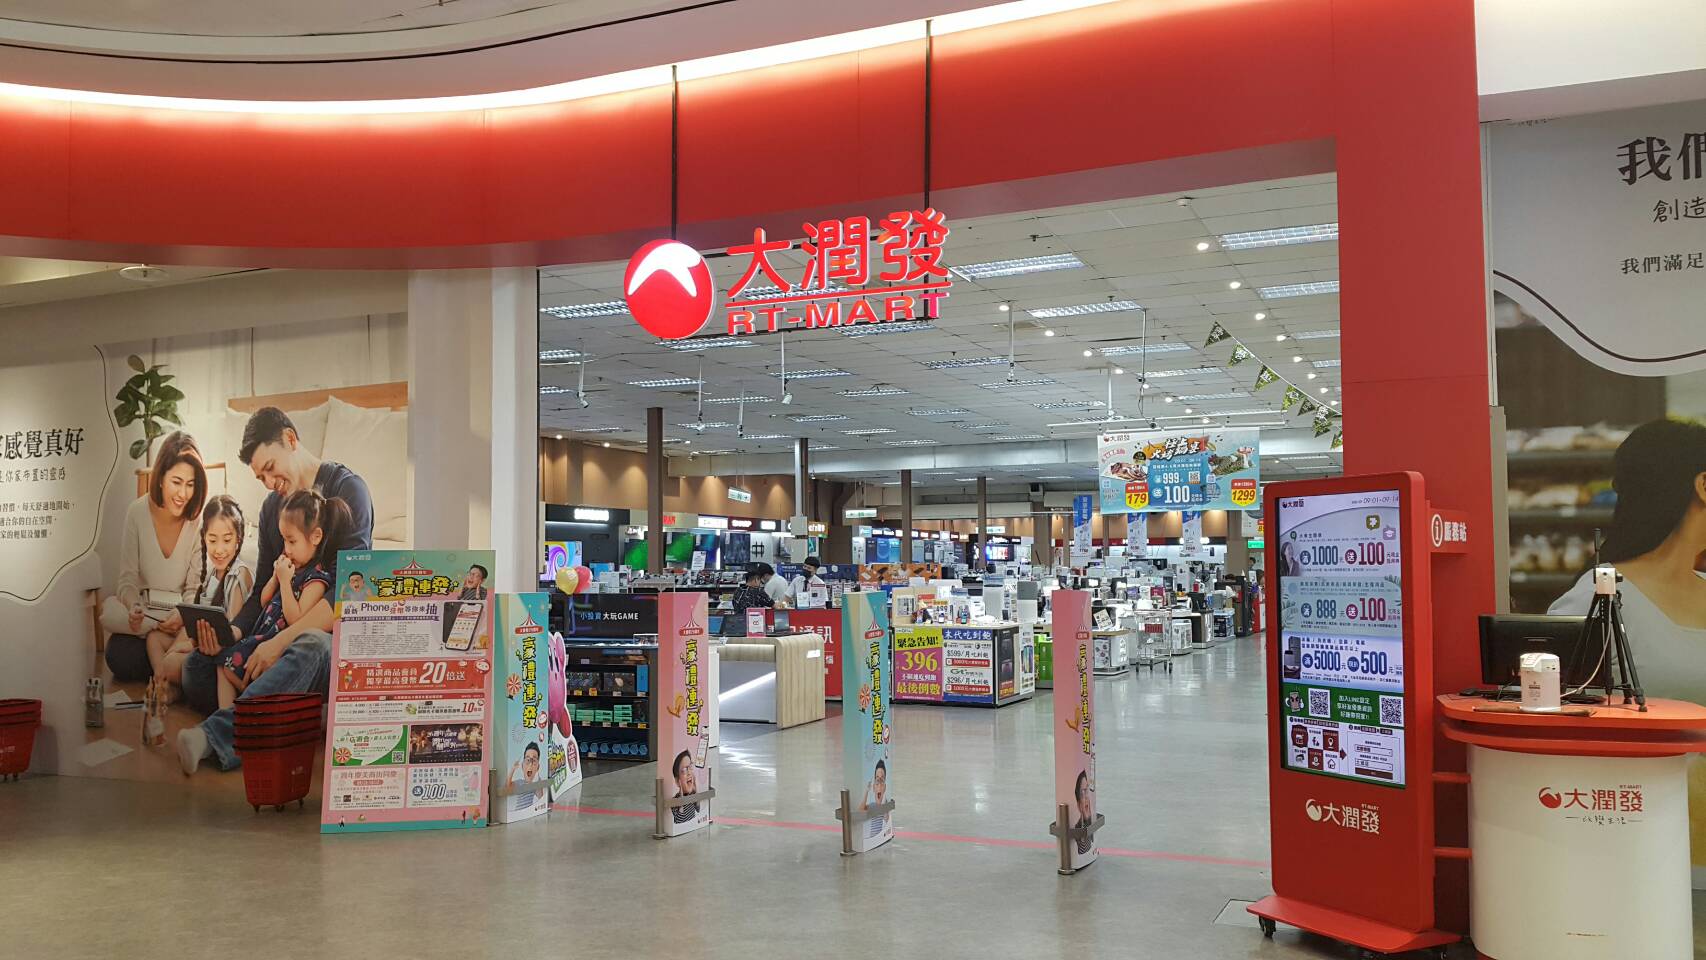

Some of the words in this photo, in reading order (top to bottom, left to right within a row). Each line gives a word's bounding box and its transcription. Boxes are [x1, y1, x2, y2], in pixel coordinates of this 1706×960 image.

[726, 207, 949, 298] 大潤發
[1620, 252, 1705, 275] 我們滿足
[727, 292, 950, 336] RT-MART
[0, 427, 84, 459] 感覺真好
[1162, 472, 1180, 484] 999
[1127, 494, 1147, 504] 179
[1164, 485, 1190, 503] 100
[1232, 490, 1256, 501] 1299
[1312, 545, 1338, 565] 1000
[1358, 542, 1385, 565] 100
[378, 576, 451, 598] 豪禮連發
[603, 612, 639, 620] 大玩GAME
[1316, 599, 1337, 619] 888
[1359, 598, 1386, 621] 100
[944, 630, 992, 640] 末代吃到飽
[419, 661, 447, 684] 20
[447, 671, 466, 681] 倍送
[901, 651, 938, 672] 396
[1314, 650, 1341, 671] 5000
[1361, 651, 1388, 675] 500
[522, 636, 537, 729] 豪禮連發
[685, 639, 699, 737] 豪禮連發
[870, 641, 884, 745] 豪禮連發
[896, 682, 941, 695] 最後倒數
[462, 702, 474, 713] 10
[422, 783, 446, 800] 100
[1564, 788, 1643, 812] 大潤發
[1322, 802, 1380, 834] 大潤發
